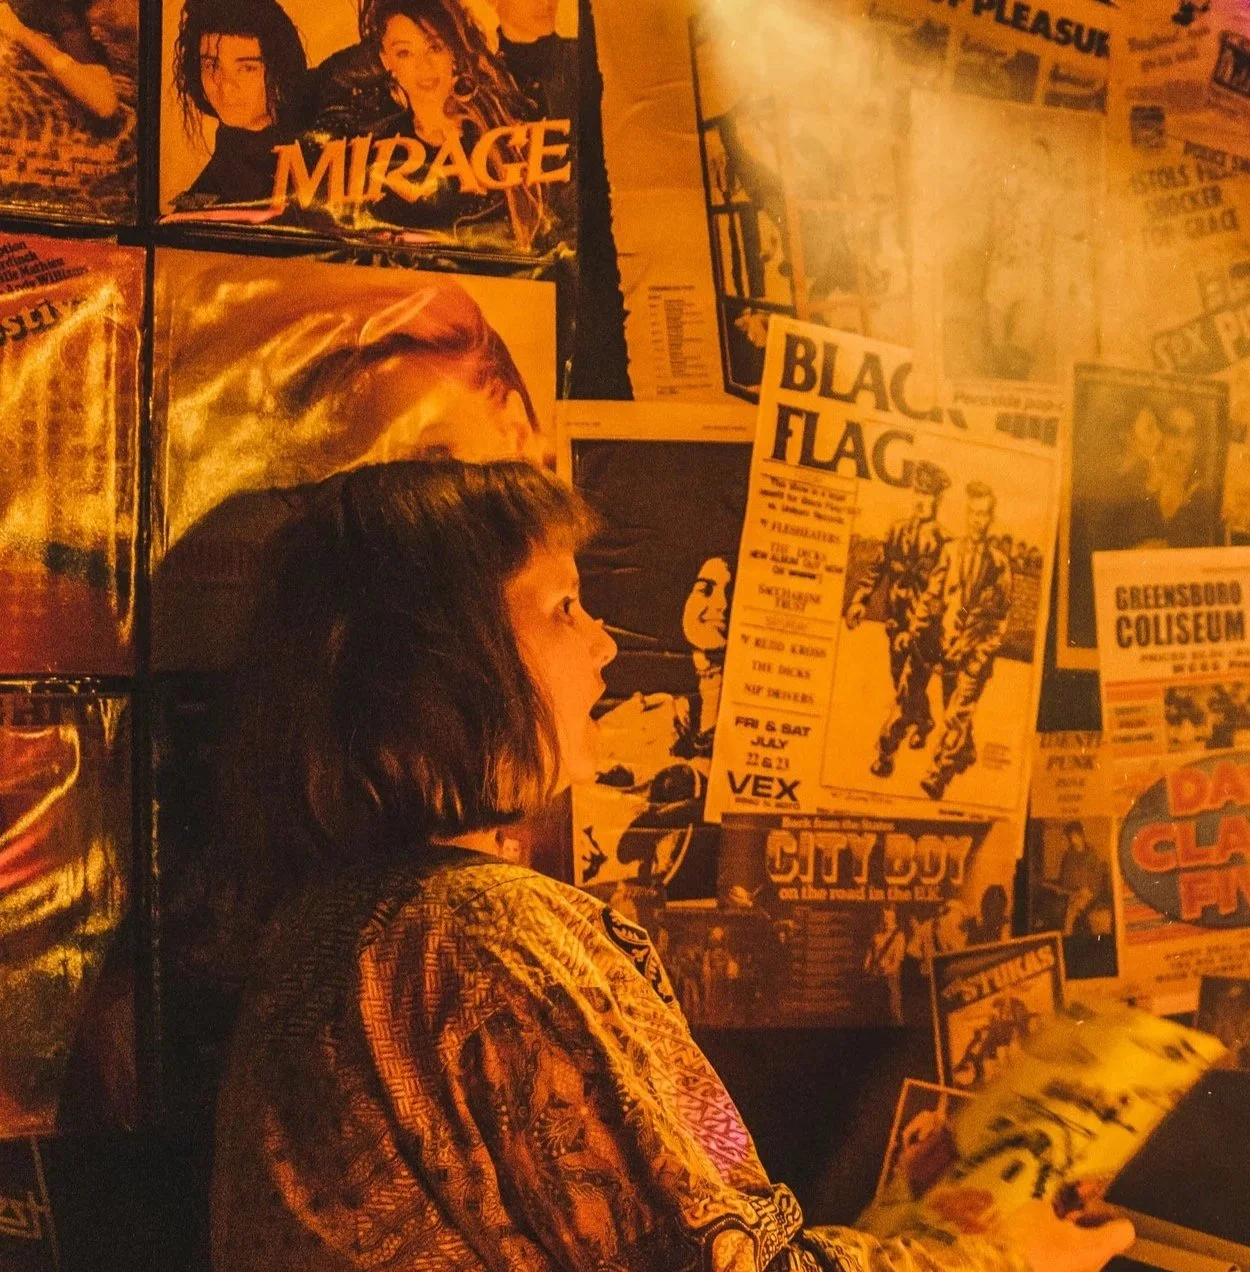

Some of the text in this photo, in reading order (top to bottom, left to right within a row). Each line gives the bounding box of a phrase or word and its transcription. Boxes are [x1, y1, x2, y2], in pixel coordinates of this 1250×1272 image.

[271, 118, 571, 208] MIRAGE
[780, 332, 968, 429] BLAC
[771, 402, 915, 489] FLAG
[1115, 579, 1242, 611] GREENSBORO
[1115, 609, 1245, 649] COLISEUM
[752, 659, 773, 674] THE
[766, 686, 815, 705] DRIVERS
[734, 715, 812, 738] FRI & SAT
[750, 735, 790, 750] JULY
[727, 770, 801, 803] VEX
[766, 829, 975, 887] CITY BOY
[778, 887, 798, 901] on
[801, 885, 827, 901] the
[829, 885, 865, 901] road
[868, 886, 884, 901] in
[887, 886, 912, 902] the
